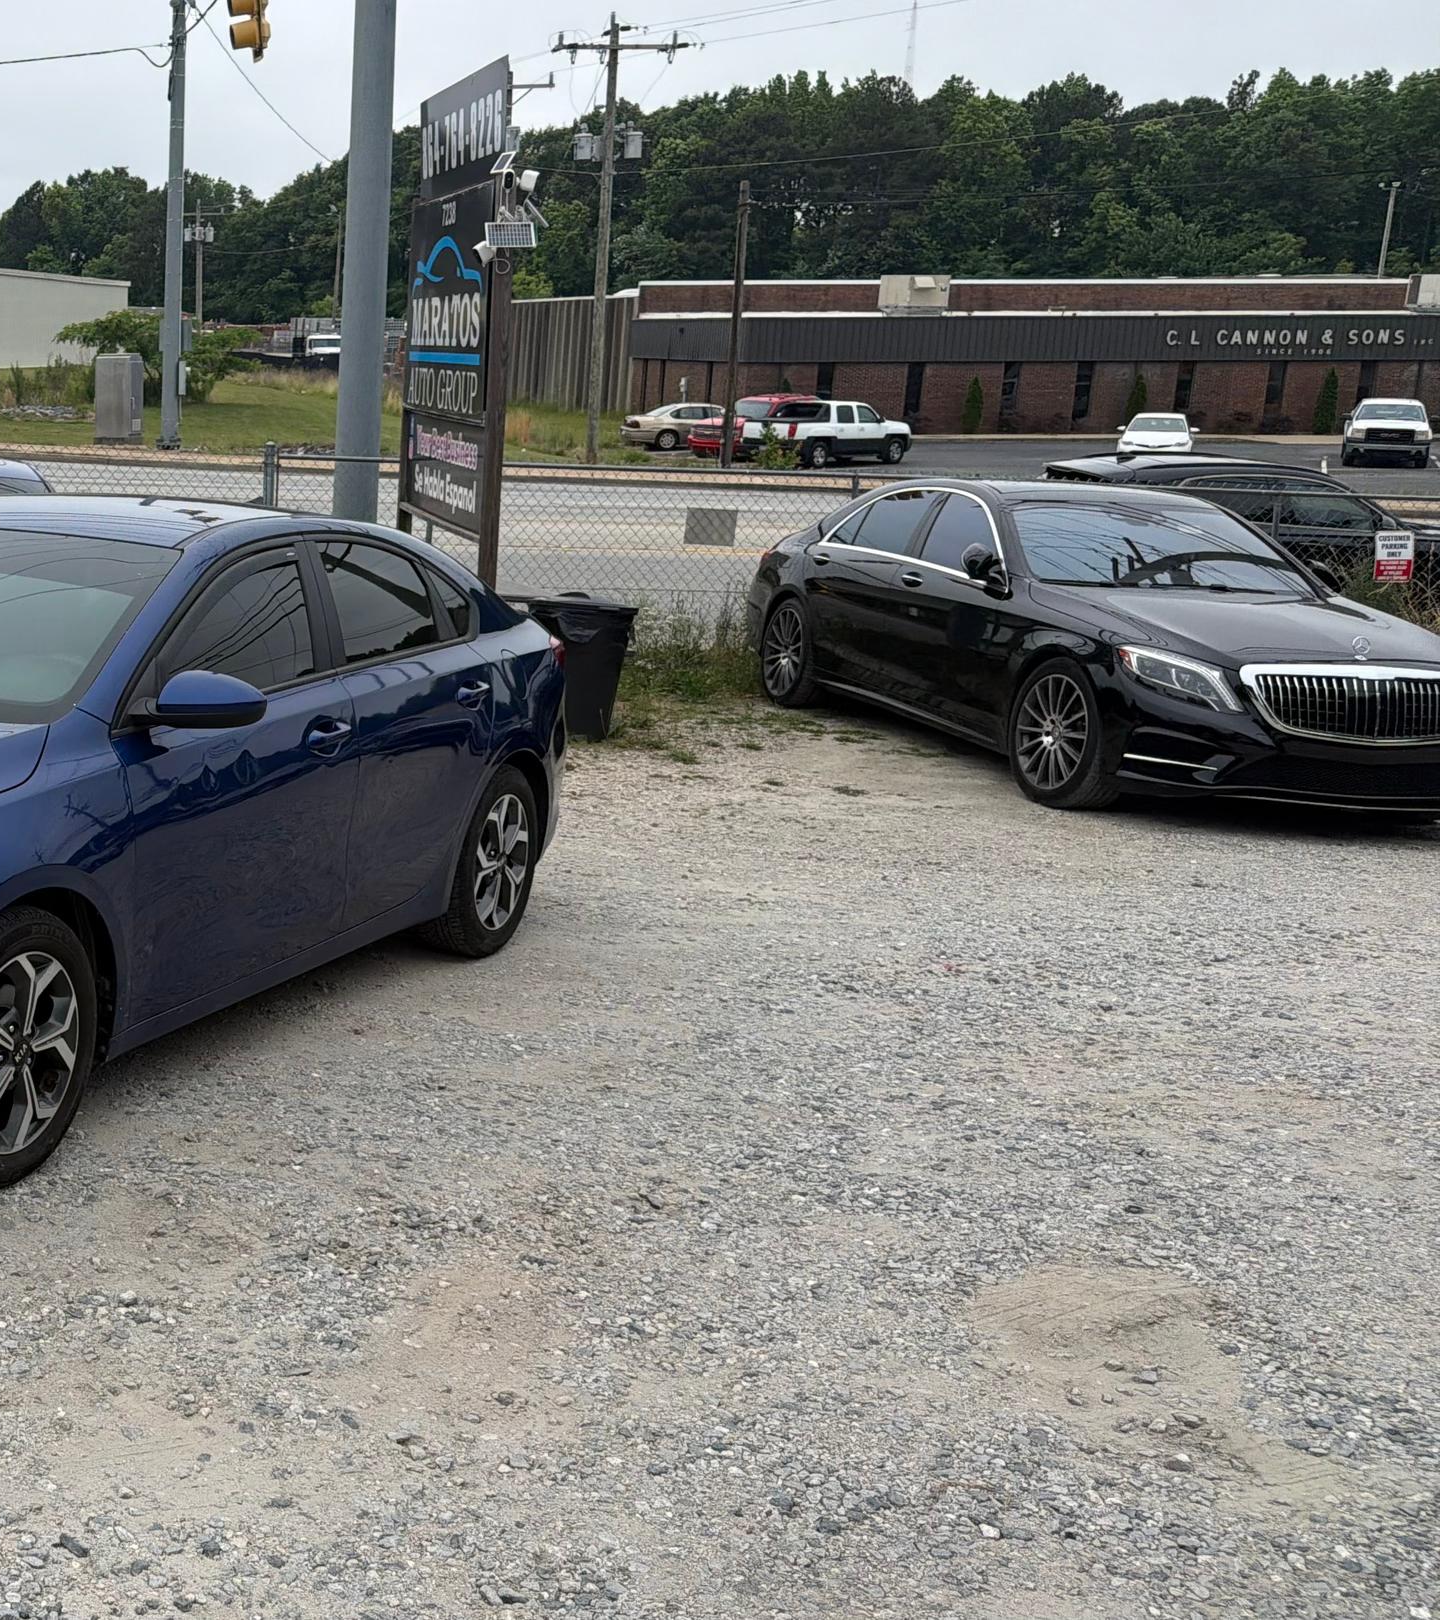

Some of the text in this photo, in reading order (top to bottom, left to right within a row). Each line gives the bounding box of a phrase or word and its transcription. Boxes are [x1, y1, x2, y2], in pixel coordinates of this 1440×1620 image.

[422, 89, 502, 180] 864-764-8226
[411, 292, 480, 348] MARATOS
[1190, 330, 1200, 345] L
[1217, 329, 1308, 345] CANNON
[1321, 329, 1333, 345] &
[1348, 329, 1405, 345] SONS
[407, 367, 478, 414] AUTO GROUP
[414, 464, 423, 493] Se
[423, 466, 444, 501] Habla
